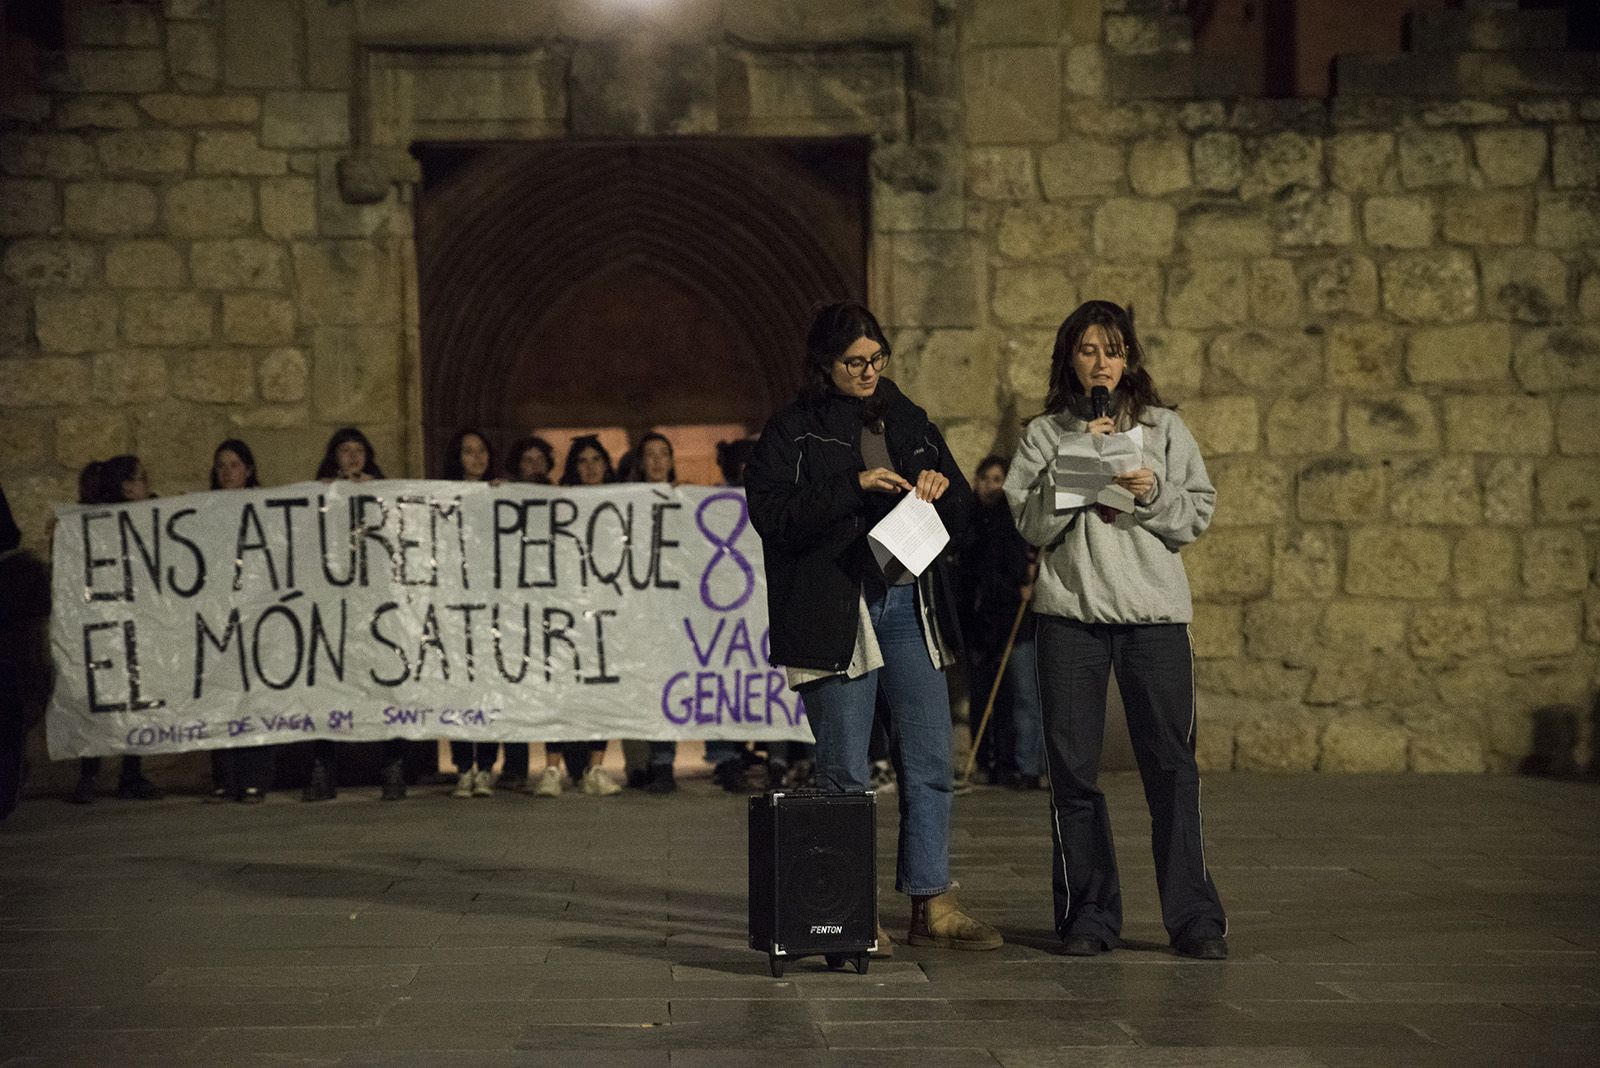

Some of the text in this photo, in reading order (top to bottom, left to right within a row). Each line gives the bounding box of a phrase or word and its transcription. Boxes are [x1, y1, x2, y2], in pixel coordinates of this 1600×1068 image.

[82, 489, 682, 602] ENS ATUREM PERQUÈ
[695, 492, 755, 612] 8
[83, 620, 166, 713] EL
[193, 591, 349, 699] MÓN
[683, 617, 769, 668] VA
[227, 716, 255, 737] DE
[260, 714, 316, 731] VAGA
[328, 710, 353, 730] 8M
[383, 706, 434, 726] SANT
[810, 925, 843, 934] FENTON
